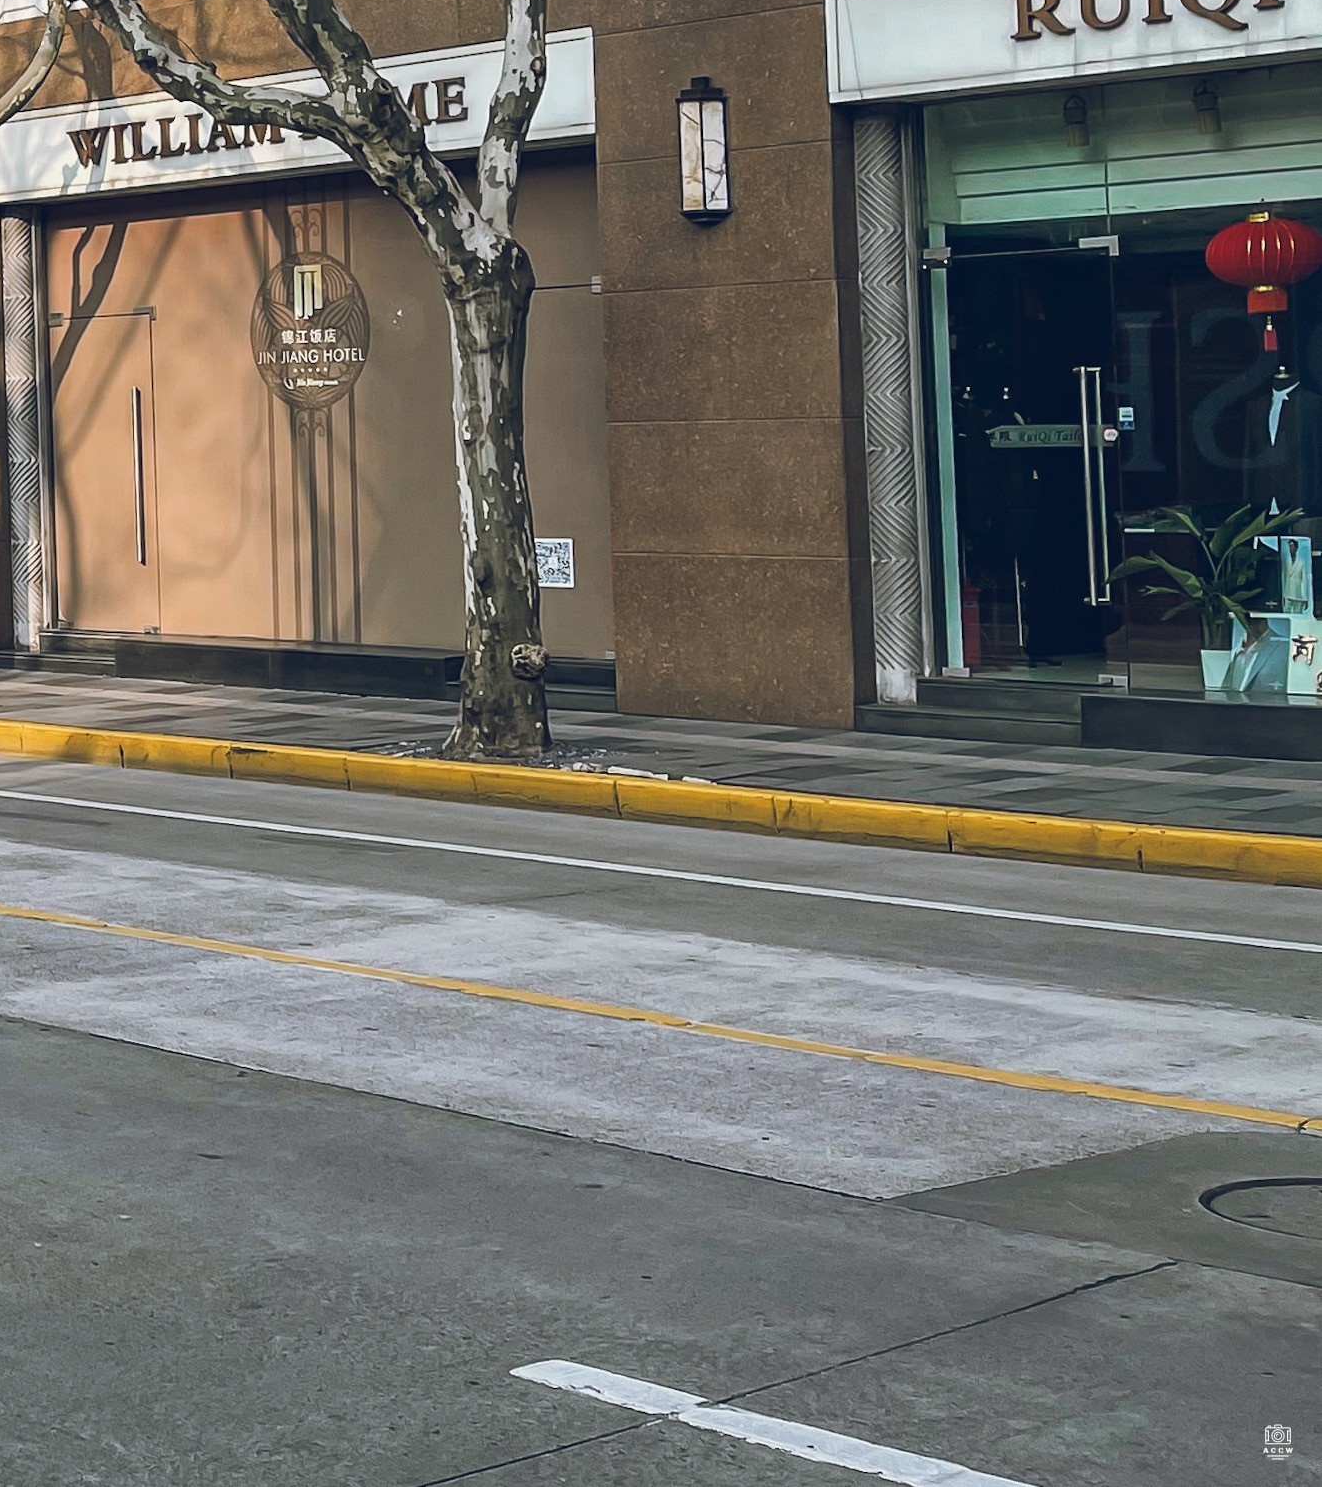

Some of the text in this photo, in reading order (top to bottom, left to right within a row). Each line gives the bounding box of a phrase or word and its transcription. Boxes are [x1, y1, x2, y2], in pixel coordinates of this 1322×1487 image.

[281, 328, 337, 345] 锦江饭店
[257, 347, 365, 365] JIN JIANG HOTEL
